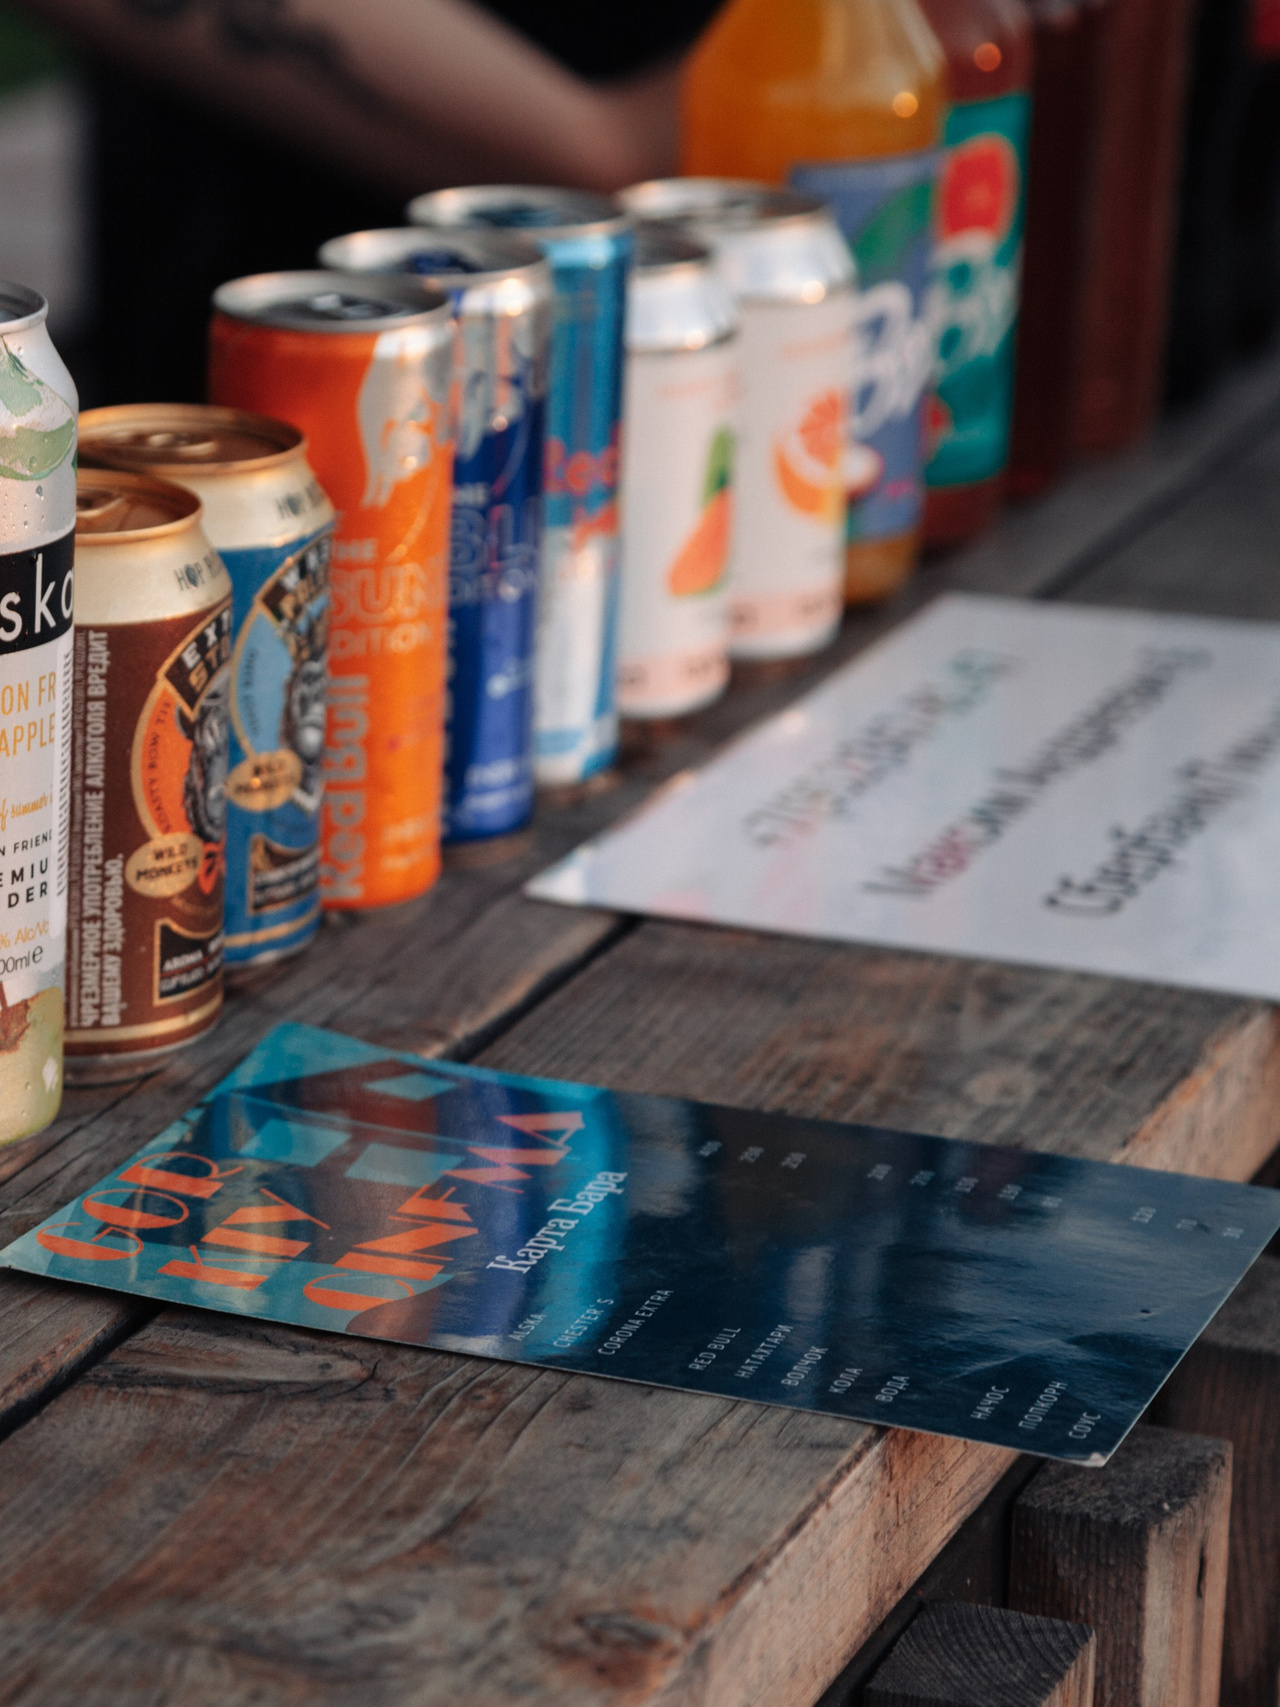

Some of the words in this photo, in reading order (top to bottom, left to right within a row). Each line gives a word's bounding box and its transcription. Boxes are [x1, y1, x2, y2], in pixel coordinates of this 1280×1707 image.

[88, 629, 111, 697] ВРЕДИТ
[85, 700, 107, 788] АЛКОГОЛЯ
[323, 674, 370, 783] Bull
[11, 796, 49, 818] summer
[83, 790, 104, 917] УПОТРЕБЛЕНИЕ
[153, 842, 187, 862] WILD
[322, 786, 367, 899] Red
[80, 918, 102, 1027] ЧРЕЗМЕРНОЕ
[101, 953, 123, 1027] ВАШЕМУ
[36, 1151, 244, 1261] GOR
[302, 1111, 586, 1311] CINEMA
[486, 1206, 578, 1275] Карта
[563, 1169, 628, 1217] Бара
[157, 1188, 331, 1291] KIY
[511, 1313, 547, 1341] ALSKA
[598, 1318, 644, 1355] CORONA
[636, 1289, 672, 1318] EXTRA
[688, 1351, 717, 1370] RED
[707, 1327, 741, 1350] BULL
[734, 1324, 794, 1378] НАТАХТАРИ
[782, 1346, 829, 1386] ВОЛЧОК
[829, 1366, 864, 1394] КОЛА
[875, 1374, 911, 1402] ВОДА
[970, 1385, 1010, 1420] НАЧОС
[1018, 1381, 1068, 1429] ПОПКОРН
[1069, 1412, 1102, 1439] СОУС
